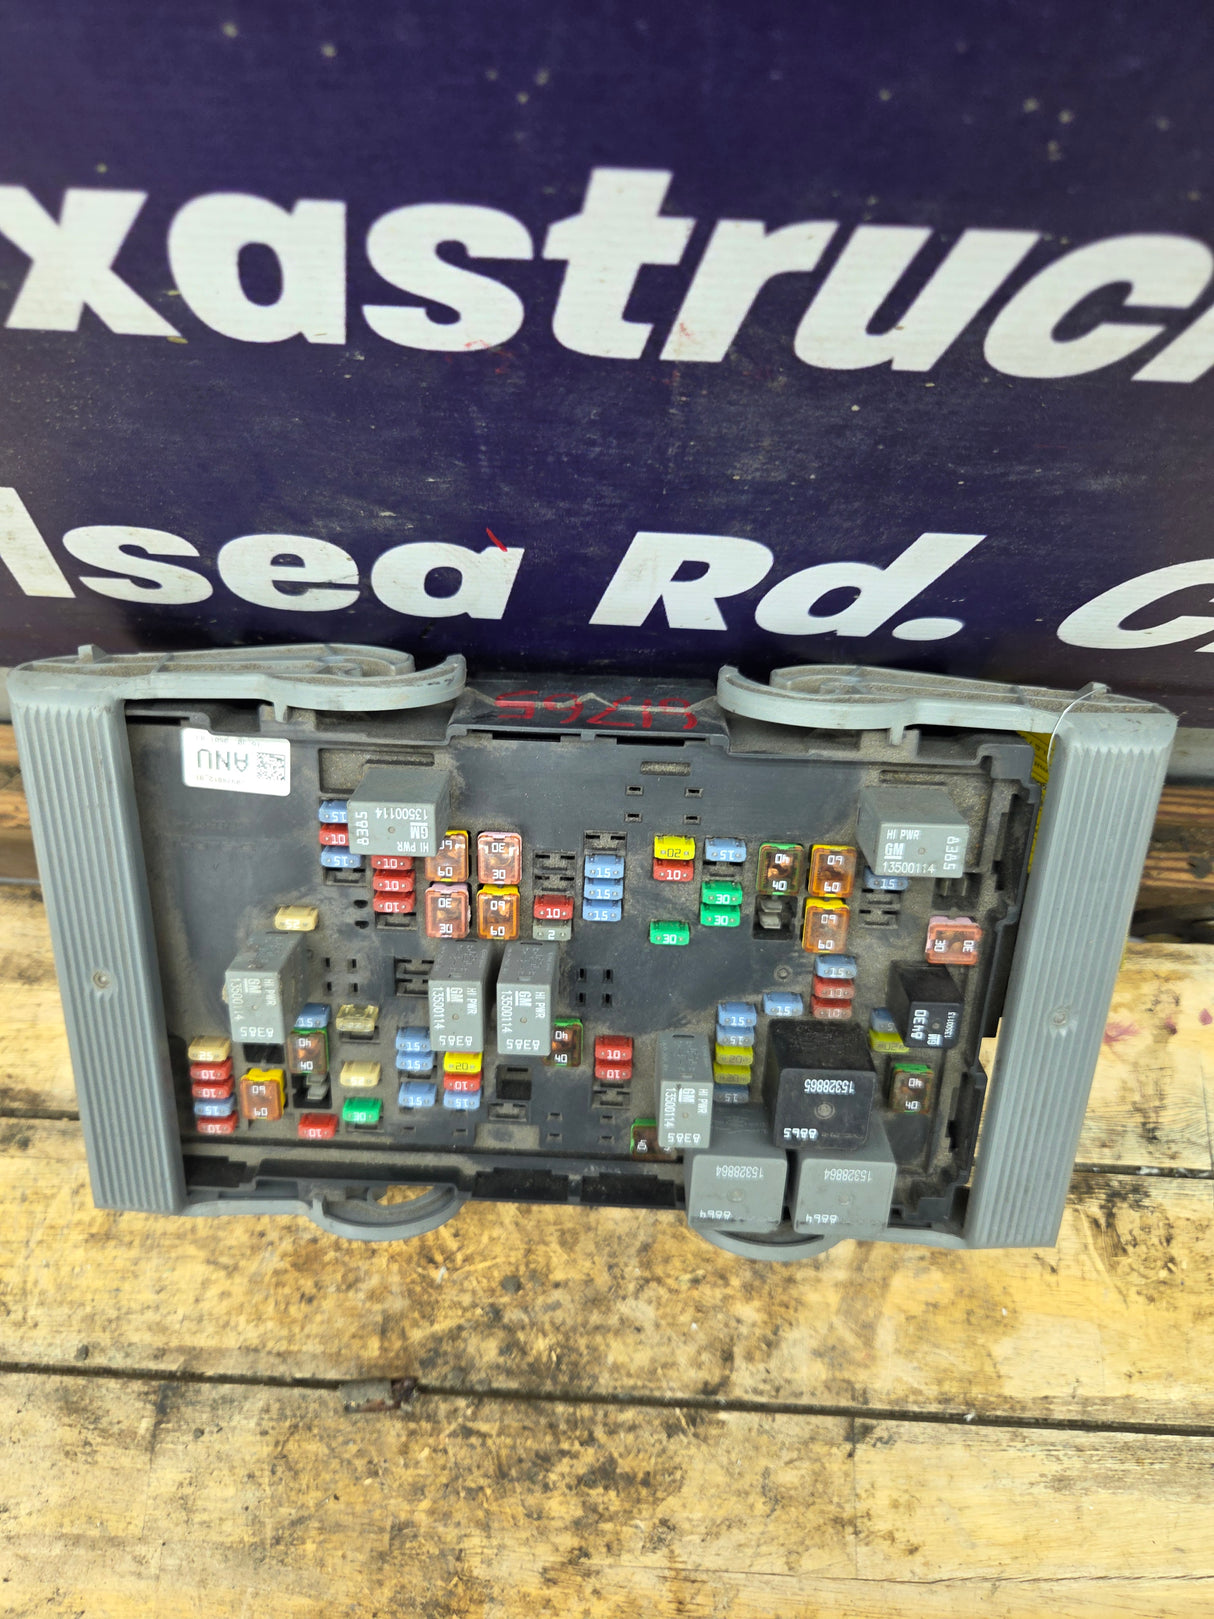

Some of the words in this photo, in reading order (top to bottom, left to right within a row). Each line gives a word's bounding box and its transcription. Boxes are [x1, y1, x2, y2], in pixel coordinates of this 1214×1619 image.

[0, 168, 1214, 383] xastruc
[589, 531, 987, 641] Rd.
[1057, 558, 1214, 652] C
[196, 749, 249, 773] ANU
[332, 812, 346, 823] 15
[375, 807, 428, 820] 13500114
[355, 811, 370, 846] 8385
[410, 825, 429, 839] GM
[331, 834, 346, 844] 10
[887, 830, 897, 840] HI
[900, 829, 920, 841] PWR
[397, 841, 417, 852] PWR
[420, 842, 429, 853] HI
[491, 842, 506, 853] 30
[885, 843, 904, 858] GM
[667, 848, 681, 858] 20
[720, 850, 735, 860] 15
[943, 836, 960, 870] 8385
[334, 856, 348, 866] 15
[383, 858, 398, 868] 10
[775, 854, 790, 864] 40
[827, 855, 844, 865] 60
[437, 867, 453, 877] 60
[882, 861, 936, 874] 13500114
[492, 870, 506, 880] 30
[596, 868, 611, 878] 15
[666, 870, 681, 880] 10
[384, 880, 399, 890] 10
[772, 881, 787, 891] 40
[824, 882, 841, 892] 60
[880, 879, 895, 889] 15
[596, 889, 611, 899] 15
[438, 898, 453, 908] 30
[715, 894, 730, 905] 30
[385, 902, 399, 913] 10
[490, 901, 506, 911] 60
[546, 908, 561, 919] 10
[594, 911, 608, 921] 15
[714, 915, 729, 926] 30
[821, 914, 837, 924] 60
[439, 924, 453, 934] 30
[490, 926, 505, 937] 60
[548, 930, 556, 940] 2
[663, 934, 677, 944] 30
[818, 940, 834, 950] 60
[933, 939, 946, 952] 30
[962, 939, 975, 953] 30
[830, 968, 844, 977] 15
[245, 978, 262, 994] GM
[265, 988, 278, 1006] PWR
[449, 987, 464, 1003] GM
[467, 987, 477, 998] HI
[535, 991, 545, 1000] HI
[229, 978, 245, 1021] 13500114
[517, 990, 532, 1007] GM
[433, 987, 446, 1030] 13500114
[467, 1000, 477, 1016] PWR
[501, 990, 513, 1033] 13500114
[535, 1002, 546, 1019] PWR
[776, 1006, 791, 1015] 15
[730, 1017, 745, 1026] 15
[911, 1009, 929, 1041] 8430
[240, 1026, 274, 1038] 8385
[555, 1030, 569, 1041] 40
[439, 1035, 473, 1047] 8385
[506, 1038, 540, 1050] 8385
[730, 1036, 744, 1045] 15
[927, 1033, 942, 1046] GM
[407, 1042, 421, 1051] 15
[554, 1053, 568, 1064] 40
[607, 1050, 621, 1059] 10
[299, 1061, 314, 1071] 40
[407, 1060, 421, 1070] 15
[454, 1062, 469, 1071] 20
[201, 1070, 216, 1080] 10
[606, 1069, 620, 1079] 10
[454, 1081, 468, 1091] 10
[804, 1078, 855, 1094] 15328865
[908, 1078, 924, 1088] 40
[202, 1088, 217, 1098] 10
[252, 1085, 266, 1095] 60
[680, 1087, 695, 1103] GM
[698, 1088, 709, 1096] HI
[409, 1096, 422, 1106] 15
[455, 1098, 469, 1108] 15
[724, 1094, 737, 1102] 15
[663, 1087, 677, 1129] 13500114
[697, 1098, 708, 1114] PWR
[905, 1101, 920, 1110] 40
[206, 1106, 219, 1116] 15
[253, 1107, 268, 1117] 60
[353, 1111, 367, 1121] 30
[208, 1124, 222, 1134] 10
[308, 1129, 322, 1138] 10
[783, 1127, 818, 1140] 8865
[667, 1132, 701, 1144] 8385
[716, 1165, 764, 1179] 15328864
[824, 1168, 873, 1182] 15328864
[699, 1209, 732, 1220] 8864
[805, 1213, 838, 1225] 8864
